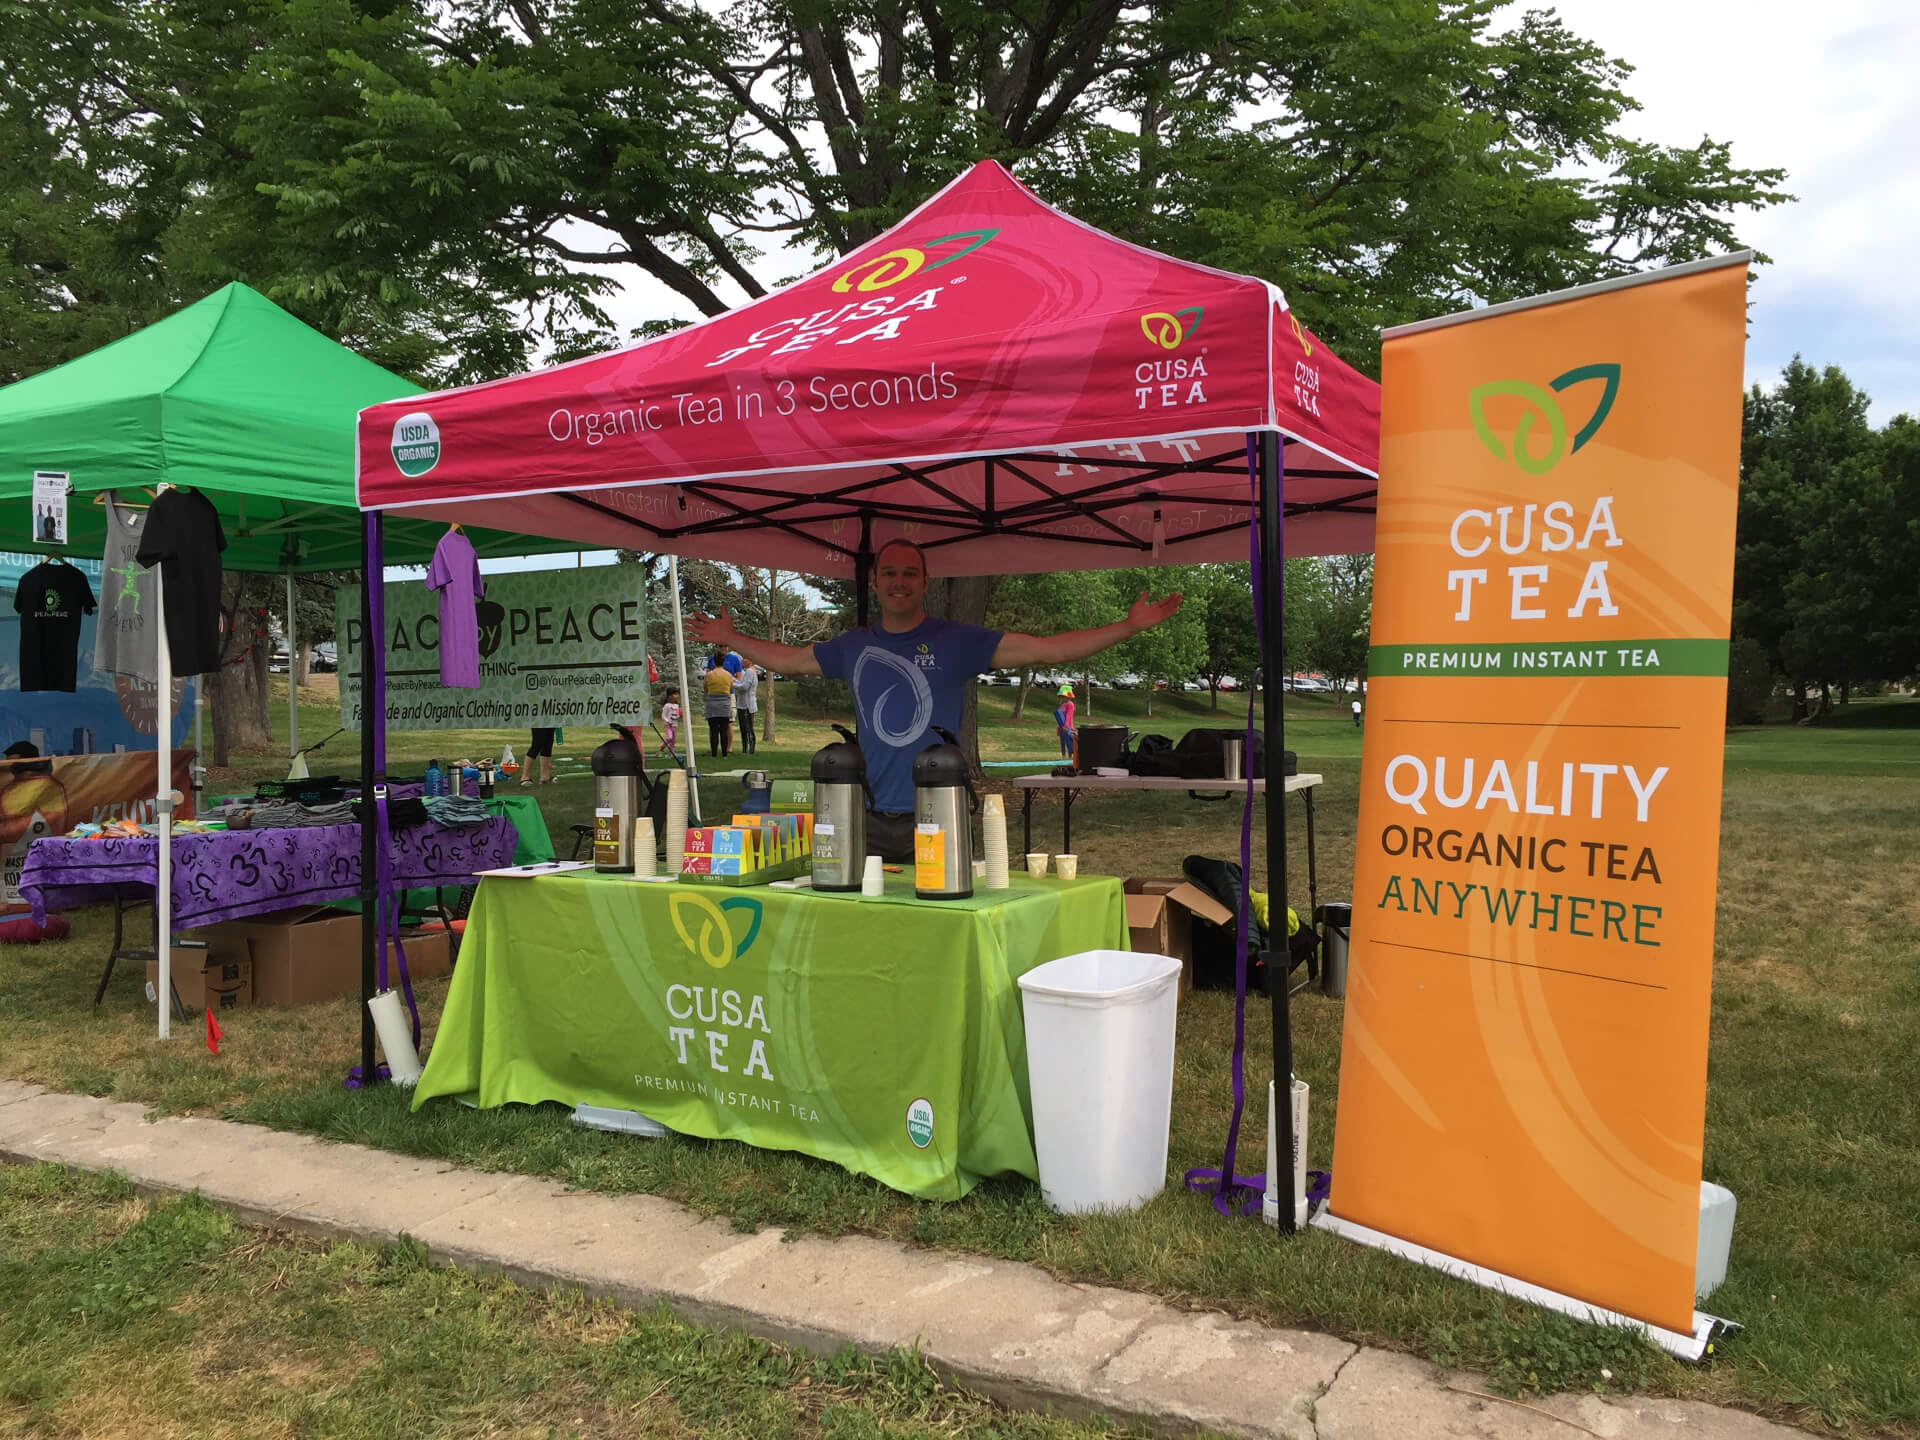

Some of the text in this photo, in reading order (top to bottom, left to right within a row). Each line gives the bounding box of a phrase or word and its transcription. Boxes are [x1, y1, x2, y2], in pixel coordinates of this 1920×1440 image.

[747, 286, 944, 343] CUSA
[704, 315, 910, 368] TEA
[1135, 356, 1208, 384] CUSA
[1294, 360, 1320, 392] CUSA
[548, 361, 959, 446] Organic Tea in 3 Seconds
[1135, 381, 1207, 410] TEA
[1293, 384, 1321, 418] TEA
[398, 445, 435, 461] ORGANIC
[401, 424, 430, 442] USDA
[1449, 496, 1624, 558] CUSA
[1447, 560, 1620, 622] TEA
[346, 614, 440, 655] PAC
[510, 601, 641, 647] PEACE
[540, 672, 635, 688] @YourPeaceByPeace
[1403, 648, 1661, 668] PREMIUM INSTANT TEA
[401, 701, 423, 720] and
[424, 701, 465, 723] Organic
[466, 699, 512, 722] Clothing
[514, 703, 529, 717] on
[531, 703, 539, 716] a
[541, 698, 585, 717] Mission
[586, 696, 603, 715] for
[605, 696, 641, 716] Peace
[1384, 754, 1670, 822] QUALITY
[1380, 824, 1662, 884] ORGANIC TEA
[1377, 875, 1662, 947] ANYWHERE
[666, 984, 772, 1033] CUSA
[669, 1026, 774, 1081] TEA
[714, 1087, 782, 1114] INSTANT
[788, 1102, 821, 1122] TEA
